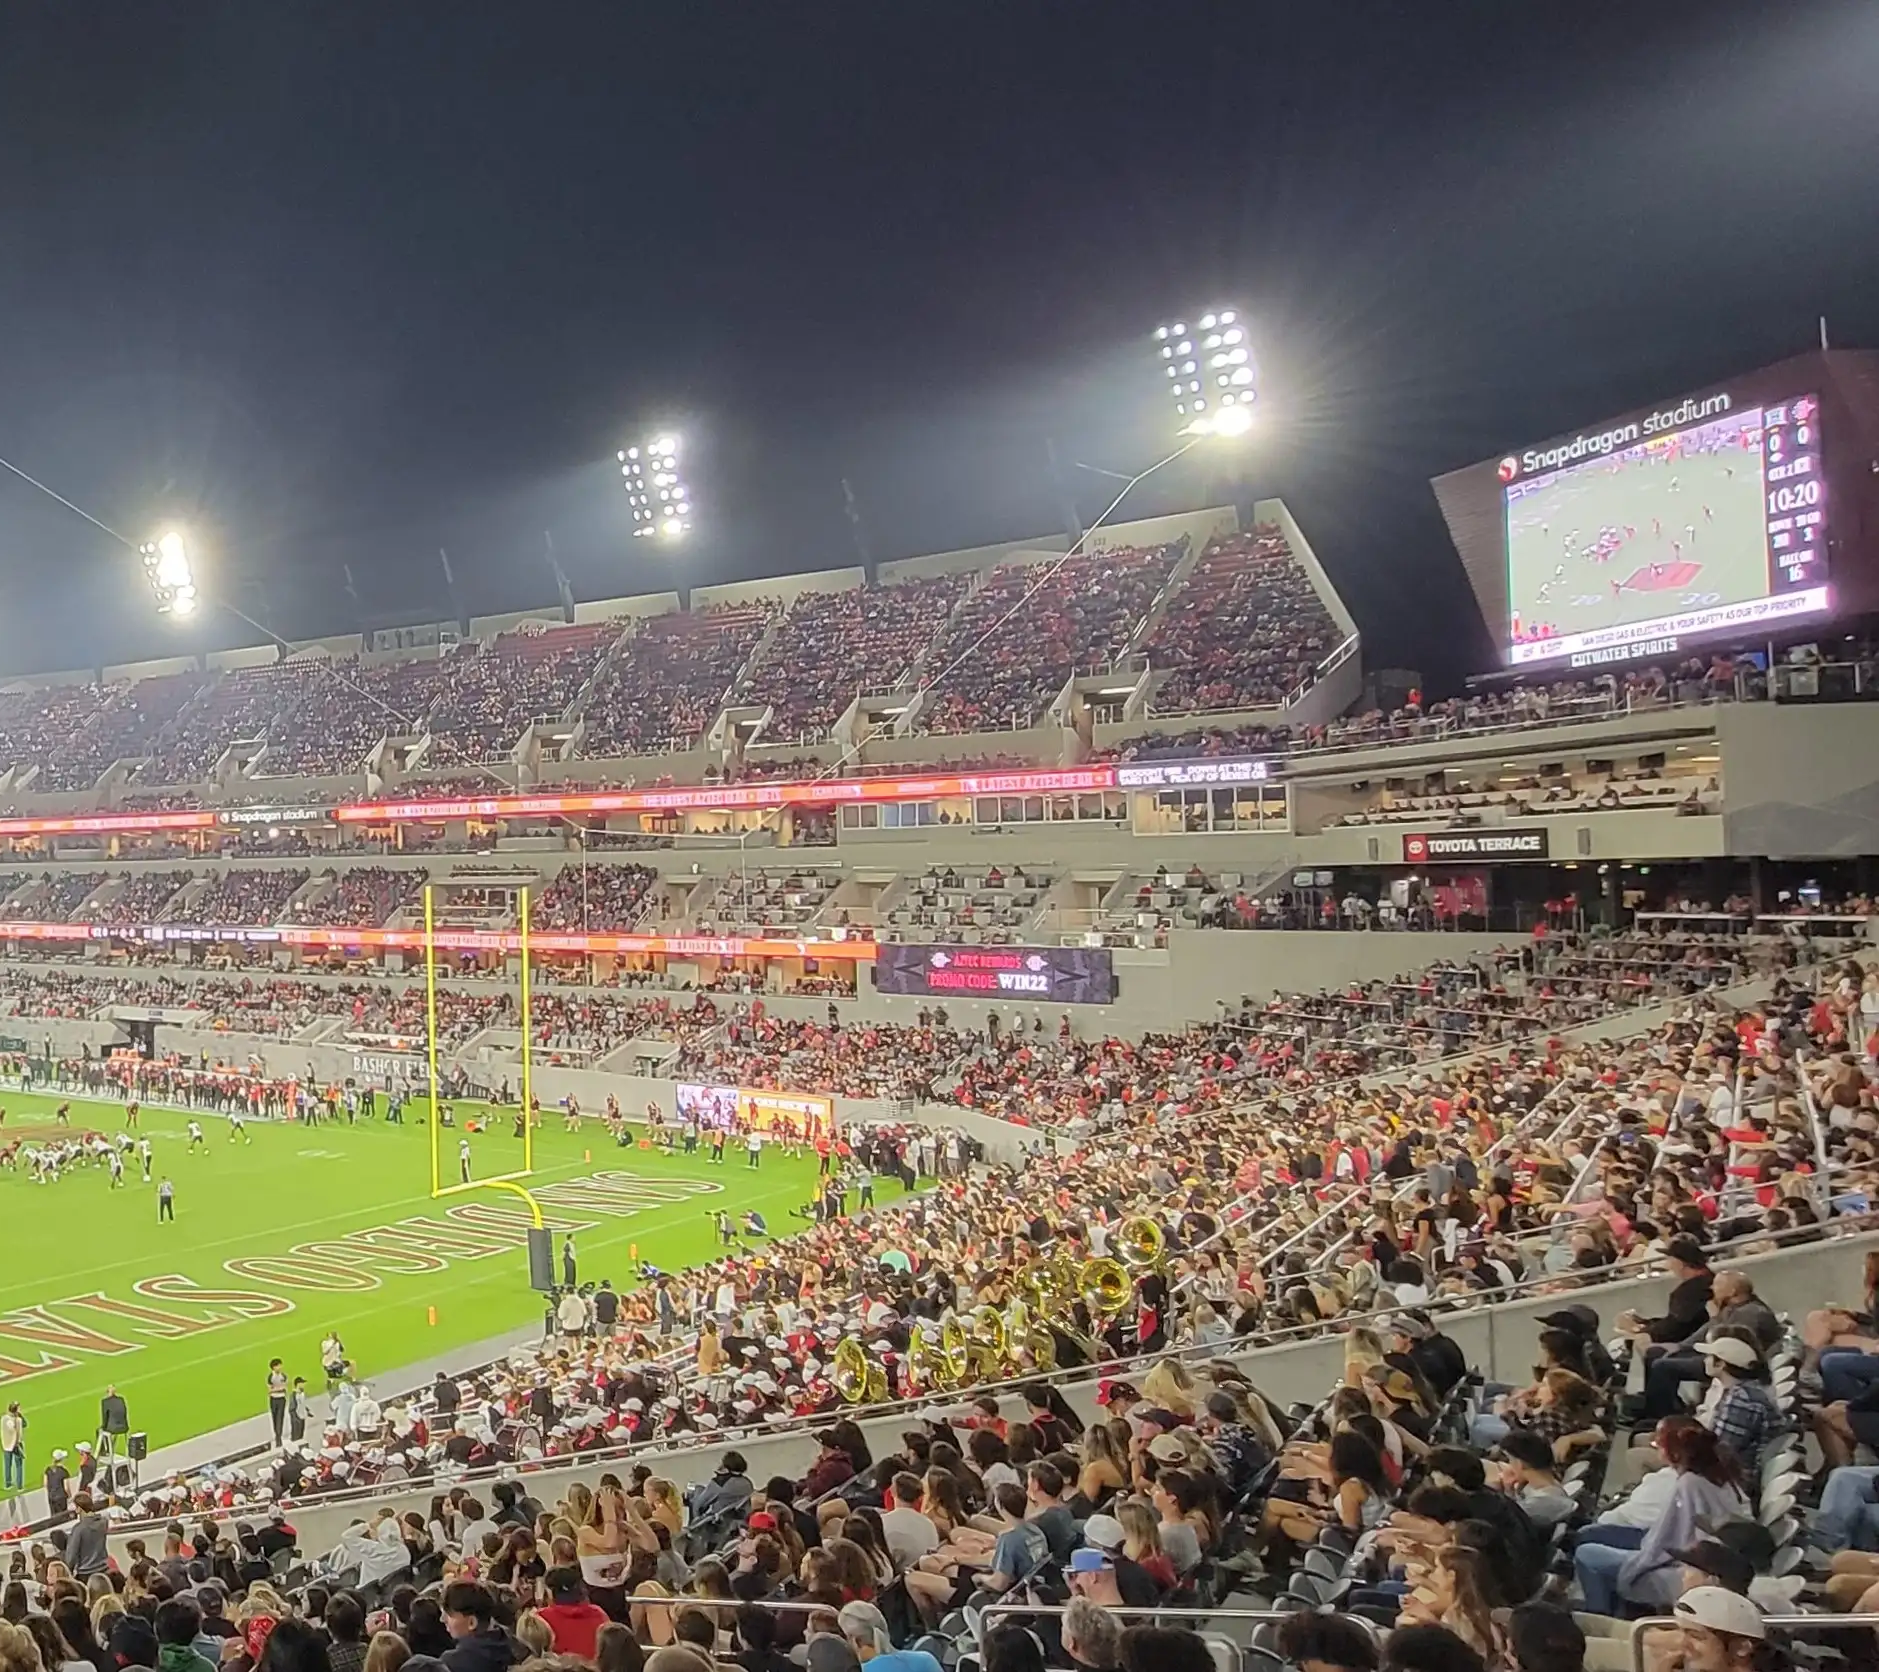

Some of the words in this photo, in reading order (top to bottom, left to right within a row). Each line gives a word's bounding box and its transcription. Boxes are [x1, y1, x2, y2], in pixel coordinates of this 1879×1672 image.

[1522, 424, 1637, 473] Snapdragon
[1643, 392, 1732, 435] stadium
[1769, 433, 1781, 451] 0
[1797, 426, 1810, 445] 0
[1768, 481, 1820, 514] 10:20
[1571, 646, 1630, 667] CUTWATER
[1631, 637, 1677, 658] SPIRITS
[231, 811, 280, 824] Snapdragon
[283, 809, 317, 820] stadium
[1427, 839, 1477, 853] TOYOTA
[1478, 836, 1541, 851] TERRACE
[998, 973, 1048, 991] WIN22
[223, 1203, 602, 1292] DIEGO
